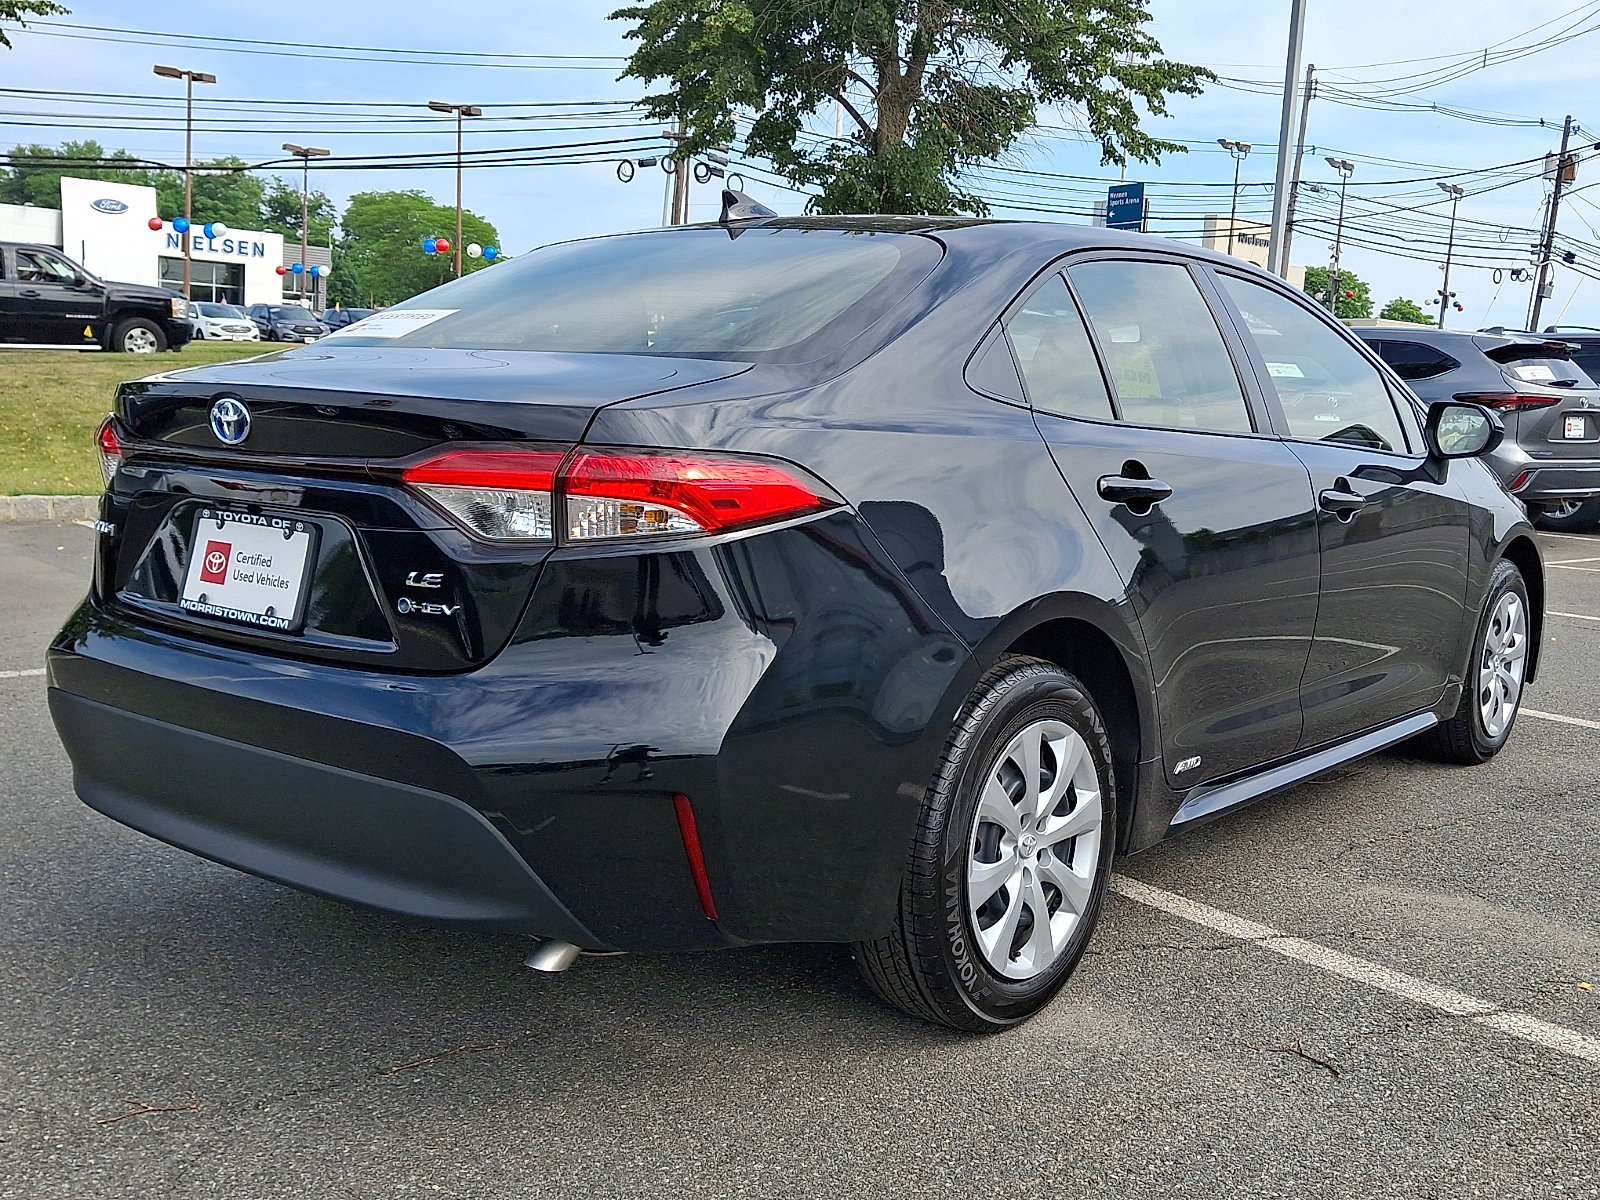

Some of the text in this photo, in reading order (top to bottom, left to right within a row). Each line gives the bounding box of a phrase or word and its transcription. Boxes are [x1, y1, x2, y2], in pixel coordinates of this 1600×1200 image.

[98, 199, 122, 211] Ford
[1109, 197, 1140, 208] Sports Arena
[166, 233, 265, 257] NELSEN
[1238, 232, 1270, 247] Nielsen
[216, 510, 291, 529] TOYOTA OF
[236, 551, 273, 568] Certified
[232, 568, 290, 590] Used Vehicles
[405, 571, 444, 588] LE
[180, 599, 289, 629] MORRISTOWN.COM
[945, 865, 978, 992] YOKOHAMA
